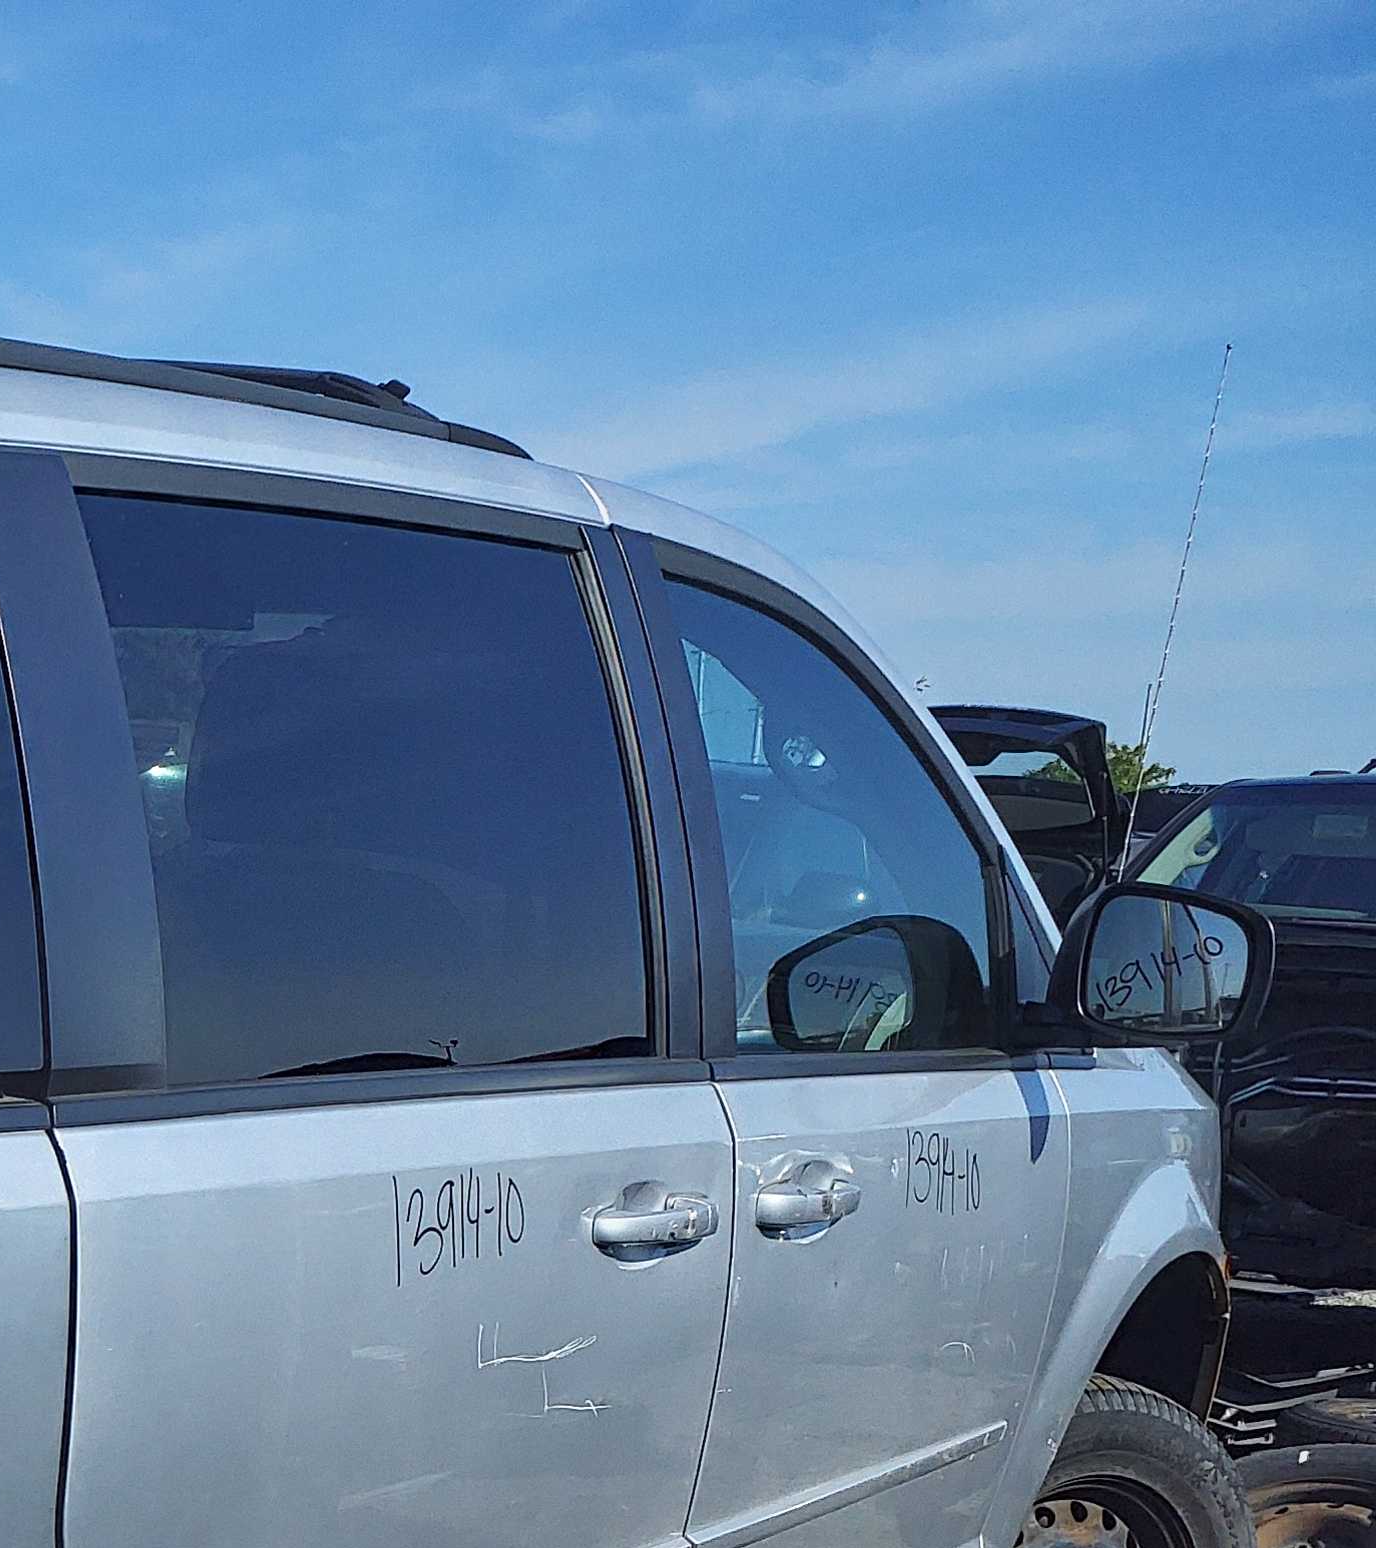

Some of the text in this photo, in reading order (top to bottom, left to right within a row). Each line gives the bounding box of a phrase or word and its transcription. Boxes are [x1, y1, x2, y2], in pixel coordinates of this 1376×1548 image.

[1095, 936, 1224, 1012] 13914-10
[905, 1127, 980, 1216] 13914-10
[392, 1167, 525, 1287] 13914-10
